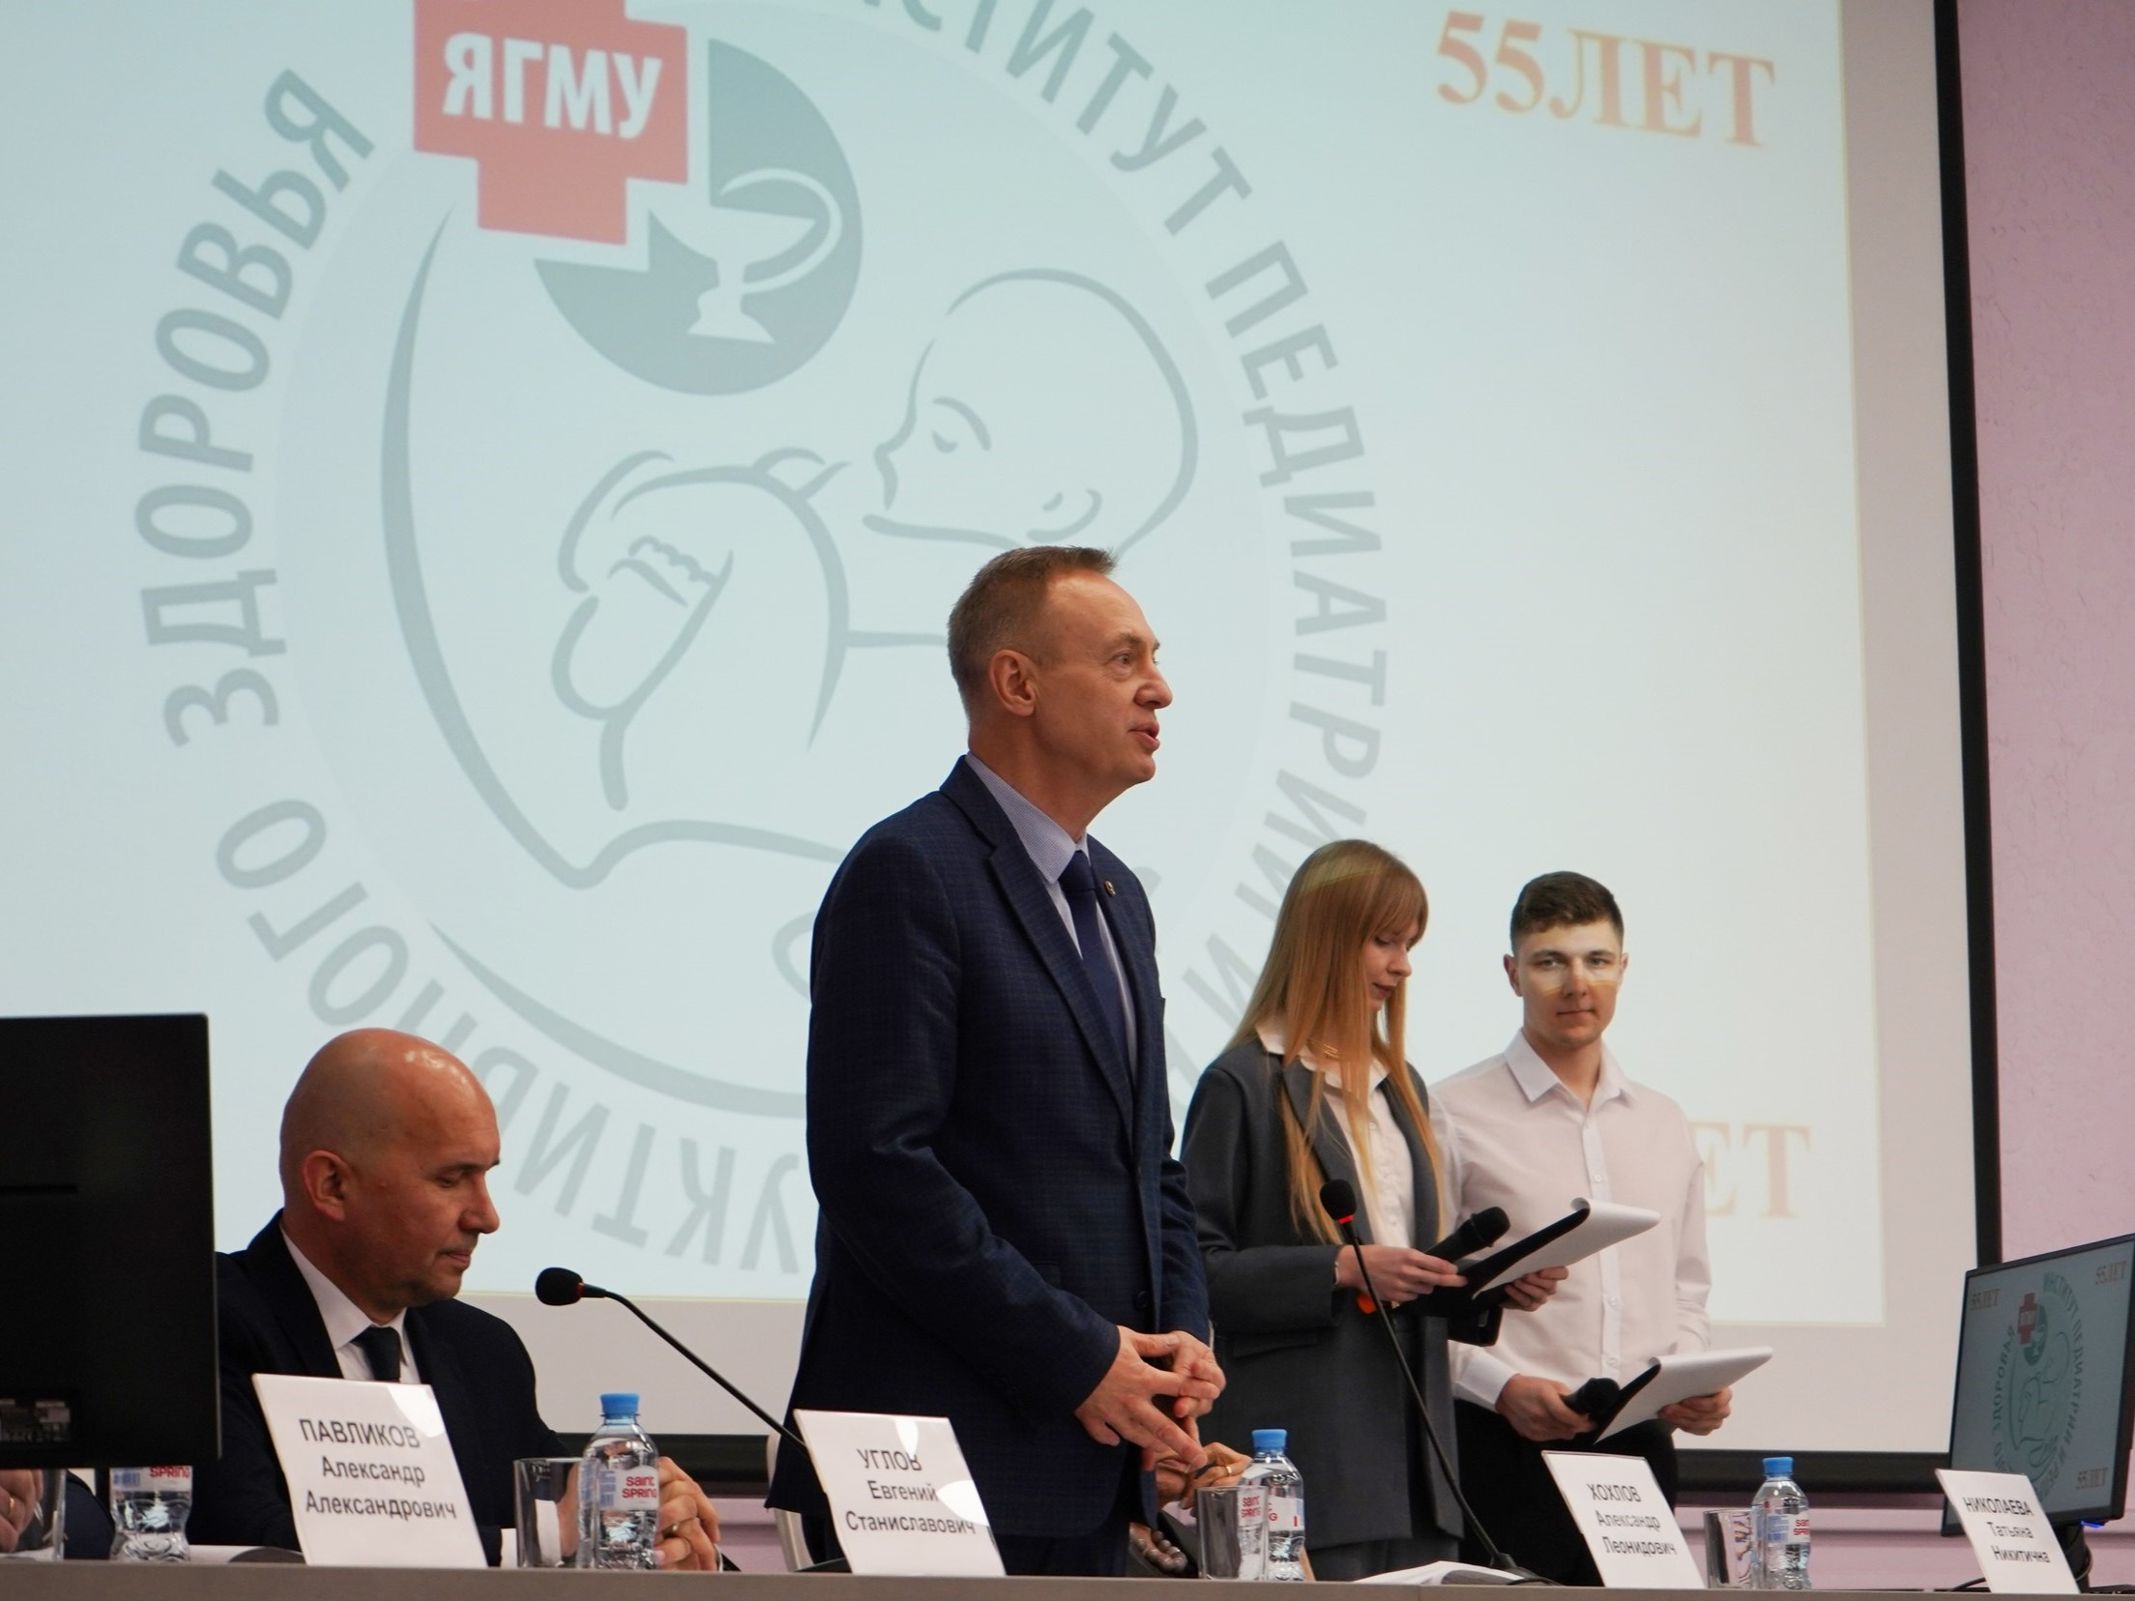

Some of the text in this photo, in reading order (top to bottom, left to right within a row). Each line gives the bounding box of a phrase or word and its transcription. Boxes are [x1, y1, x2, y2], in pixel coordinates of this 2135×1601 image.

[443, 32, 662, 140] ЯГМУ
[1436, 10, 1776, 148] 55ЛЕТ
[134, 68, 375, 747] ЗДОРОВЬЯ
[1688, 1120, 1812, 1220] ЕТ
[299, 1419, 421, 1449] ПАВЛИКОВ
[322, 1455, 426, 1488] Александр
[856, 1448, 923, 1471] УГЛОВ
[867, 1480, 939, 1501] Евгений
[1586, 1484, 1642, 1502] ХОХЛОВ
[305, 1490, 457, 1521] Александрович
[1962, 1497, 2034, 1517] НИКОЛАЕВА
[845, 1510, 976, 1535] Станиславович
[1595, 1510, 1661, 1533] Александр
[1602, 1536, 1678, 1557] Леонидович
[1991, 1545, 2051, 1563] Никитична
